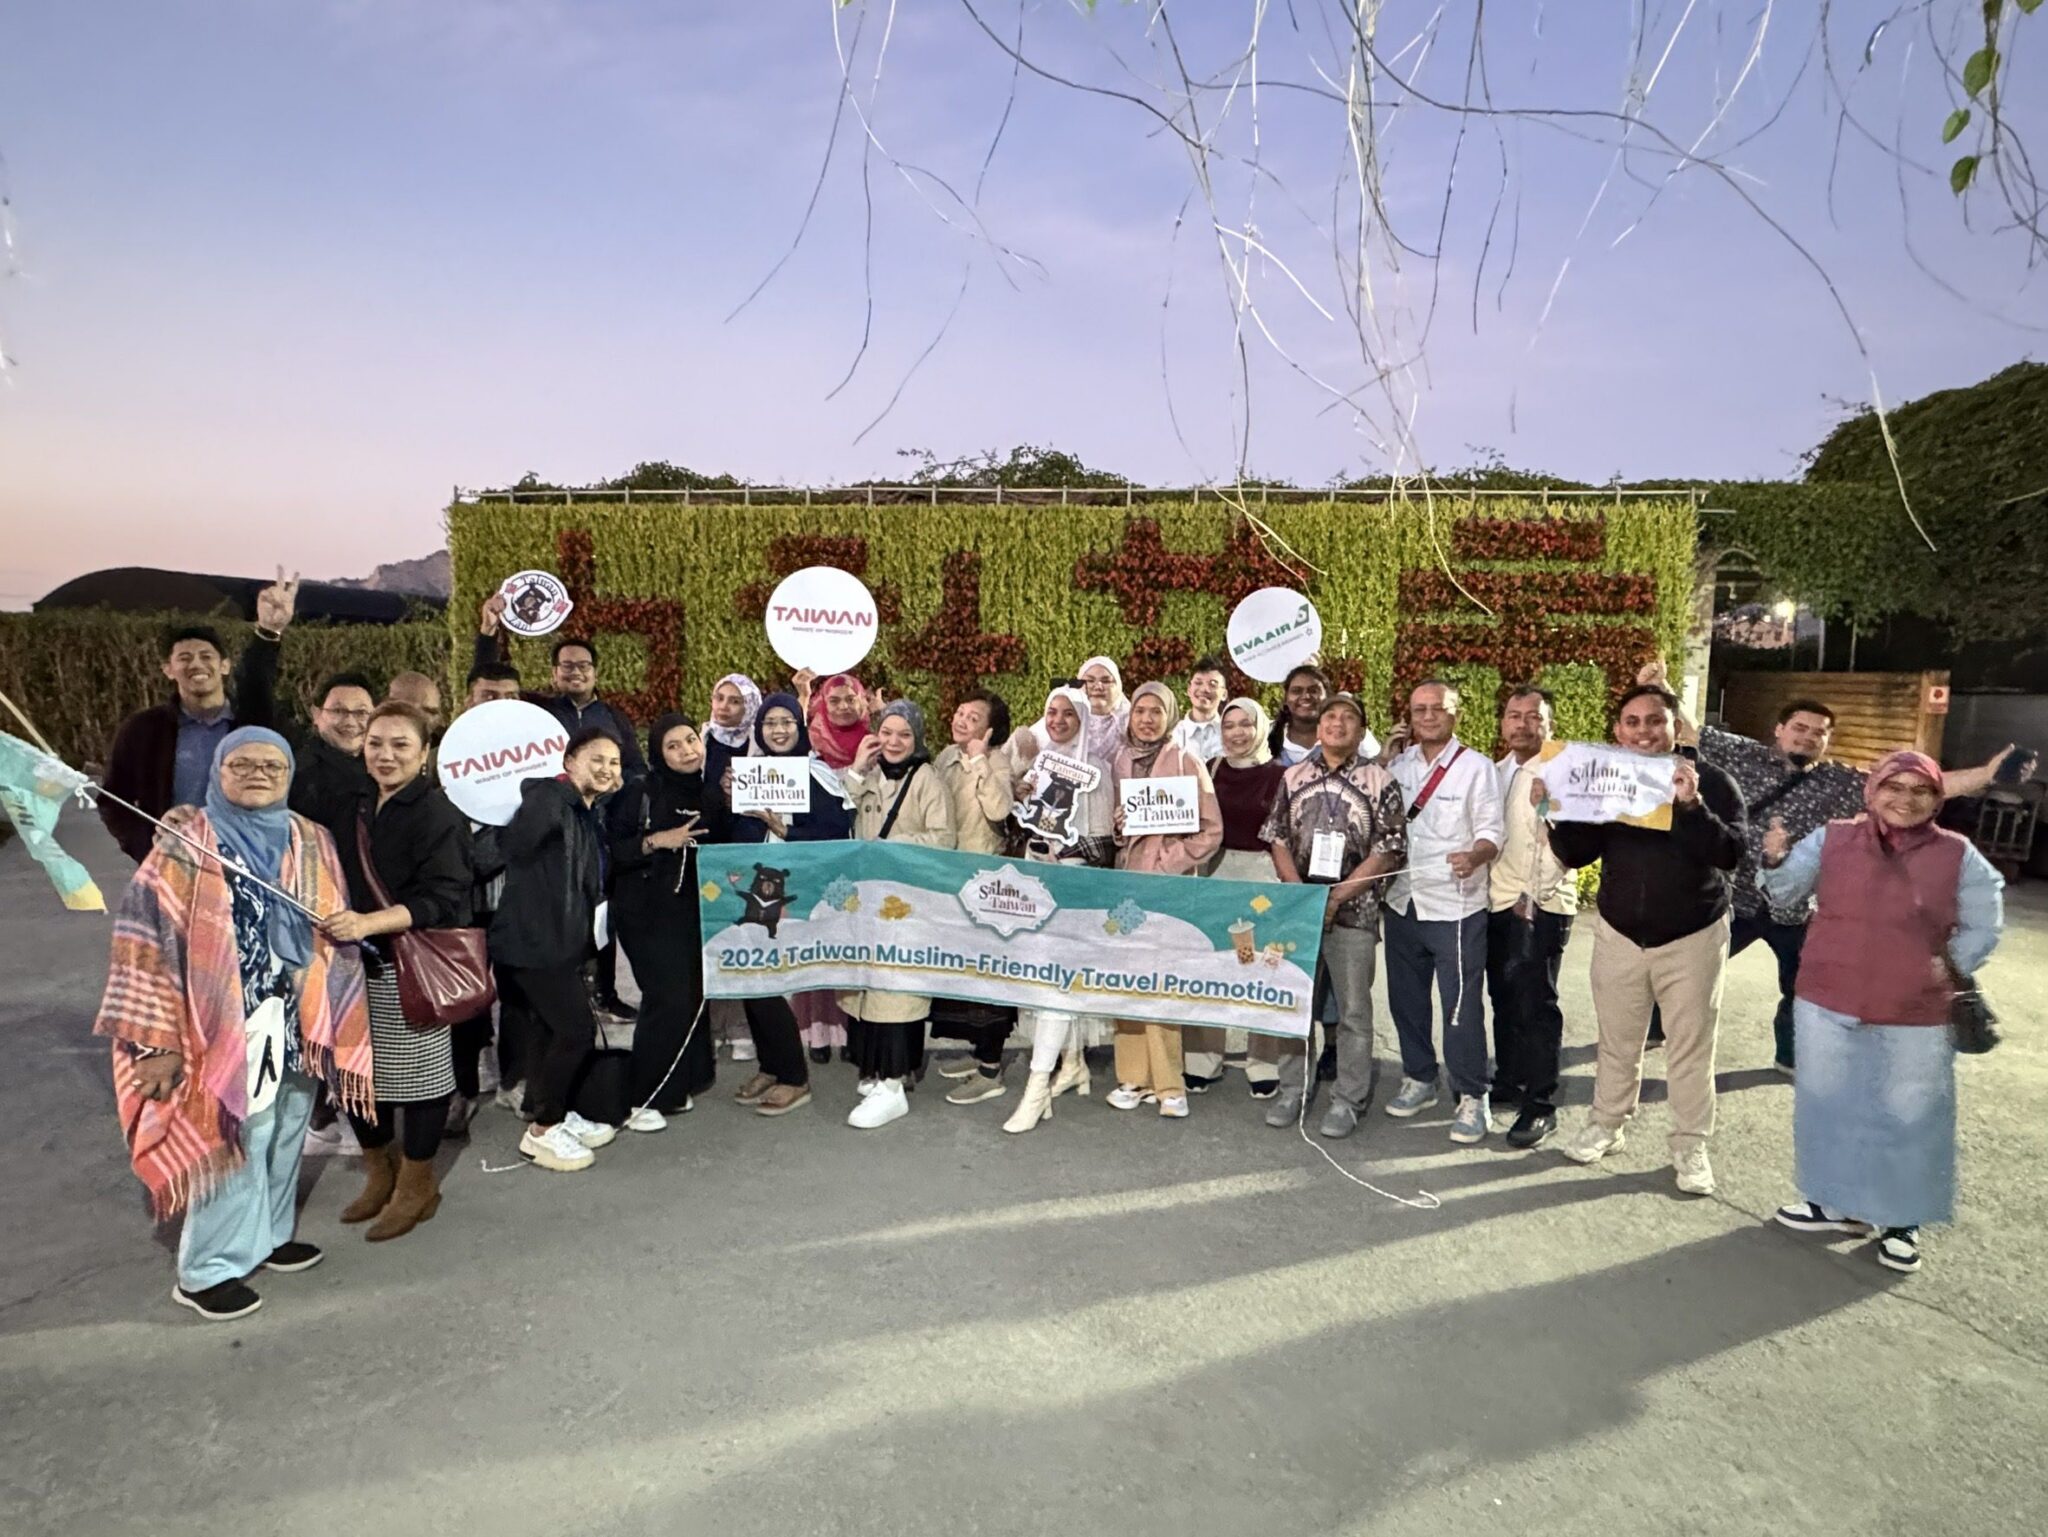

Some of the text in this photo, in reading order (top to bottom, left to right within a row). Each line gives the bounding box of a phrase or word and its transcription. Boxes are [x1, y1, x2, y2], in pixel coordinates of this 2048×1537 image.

[773, 605, 872, 627] TAIWAN
[1233, 636, 1264, 656] EVA
[1265, 623, 1291, 641] AIR
[443, 735, 565, 779] TAIWAN
[737, 764, 785, 790] Salam
[1051, 760, 1084, 779] Taiwan
[749, 785, 805, 800] Taiwan
[1127, 786, 1173, 813] Salam
[1139, 806, 1194, 822] Taiwan
[979, 880, 1020, 900] Salam
[990, 896, 1037, 913] Taiwan
[721, 940, 1294, 1006] 2024 Taiwan Muslim-Friendly Travel Promotion
